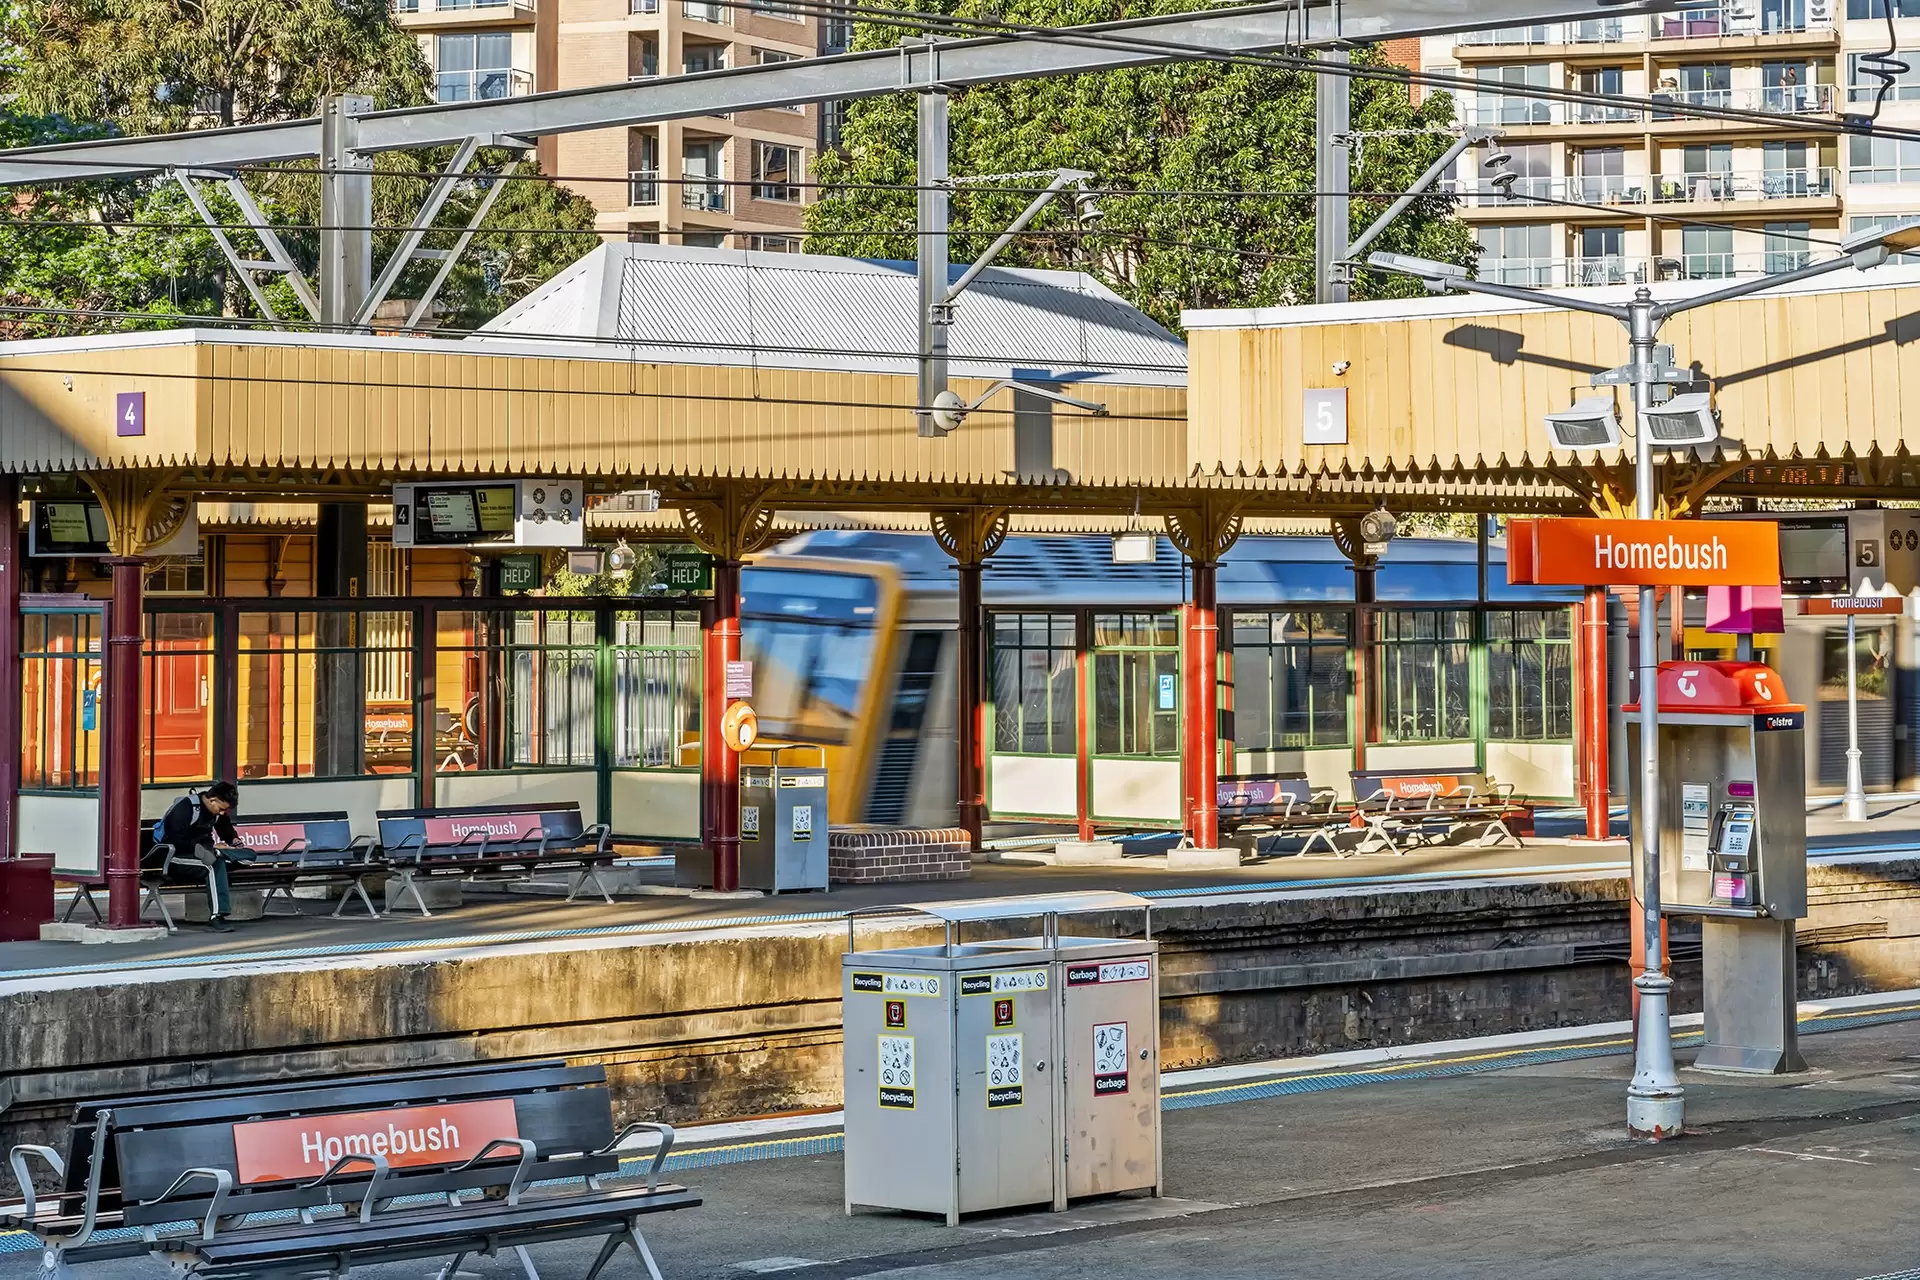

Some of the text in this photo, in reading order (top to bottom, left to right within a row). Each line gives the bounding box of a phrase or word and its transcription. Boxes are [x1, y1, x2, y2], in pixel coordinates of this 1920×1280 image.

[124, 401, 136, 426] 4
[1316, 401, 1333, 431] 5
[397, 506, 407, 524] 4
[1594, 534, 1728, 571] Homebush
[1861, 543, 1875, 565] 5
[504, 560, 532, 569] Emergency
[672, 560, 701, 569] Emergency
[504, 569, 531, 584] HELP
[672, 568, 701, 584] HELP
[1831, 598, 1883, 609] Homebush
[365, 718, 408, 729] Homebush
[1767, 717, 1793, 729] Telstra
[1399, 780, 1444, 794] Homebush
[451, 820, 518, 837] Homebush
[1069, 969, 1098, 980] Garbage
[854, 977, 882, 988] Recycling
[962, 980, 991, 990] Recycling
[1096, 1078, 1127, 1090] Garbage
[880, 1091, 914, 1105] Recycling
[989, 1090, 1022, 1103] Recycling
[301, 1117, 460, 1165] Homebush
